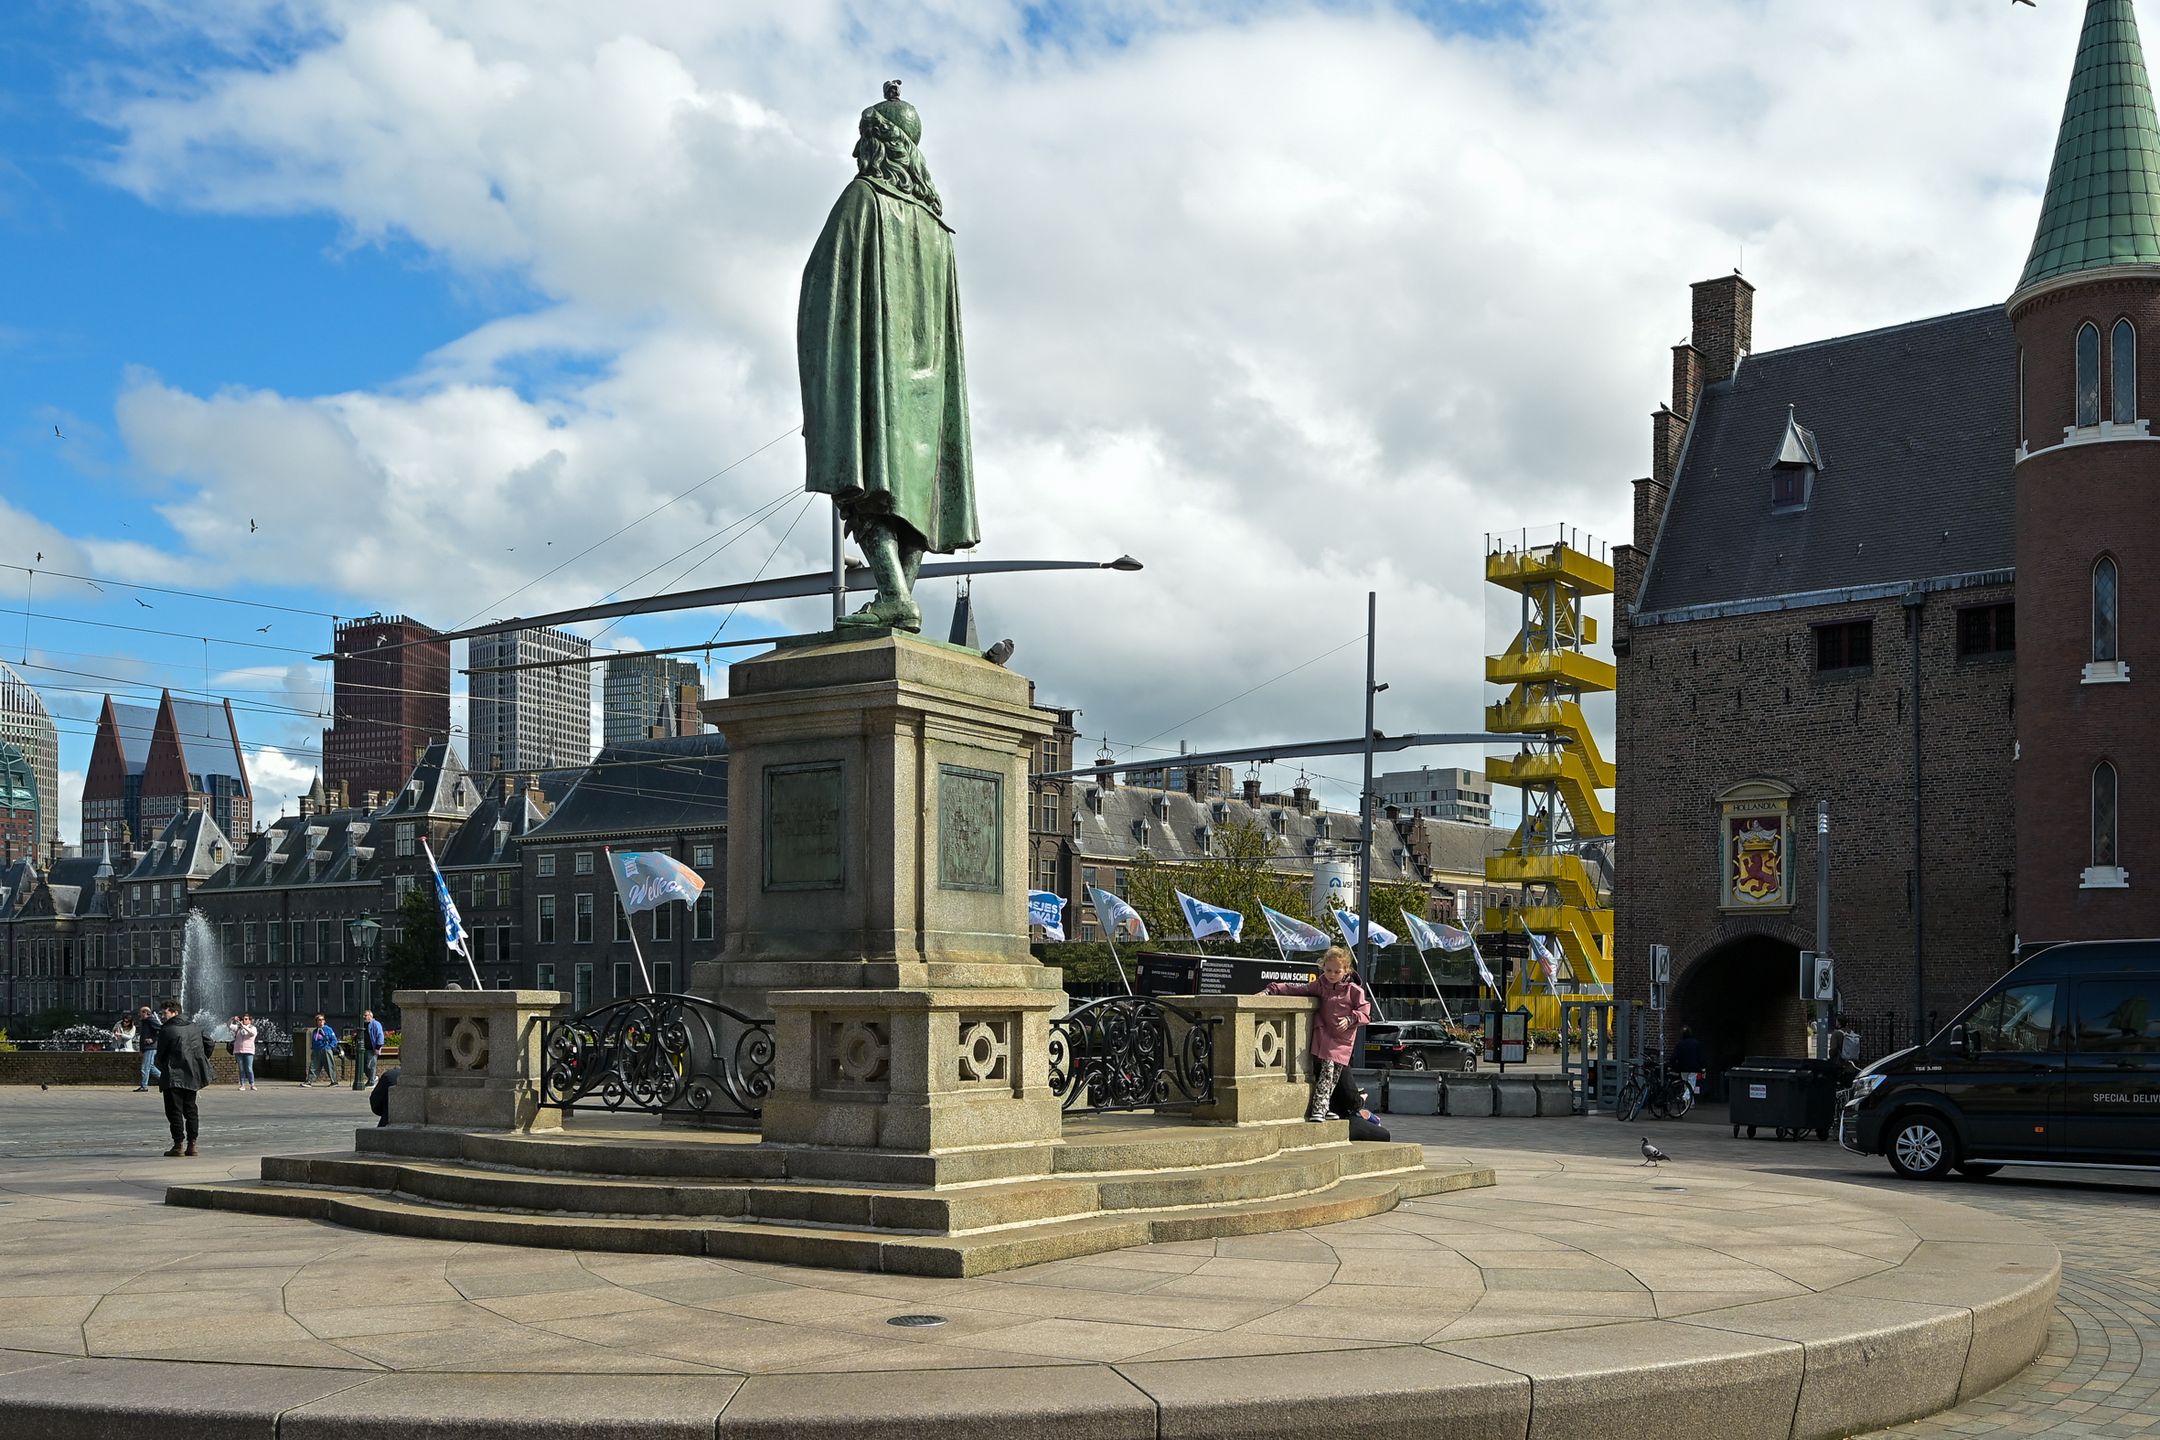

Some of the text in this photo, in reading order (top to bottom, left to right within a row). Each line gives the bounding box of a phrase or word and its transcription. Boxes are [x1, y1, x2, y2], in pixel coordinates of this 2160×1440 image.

[1733, 803, 1777, 812] HOLLANDIA
[1261, 970, 1280, 980] DAVID
[1280, 972, 1292, 981] VAN
[1292, 973, 1309, 982] SCHIE
[2093, 1093, 2131, 1103] SPECIAL
